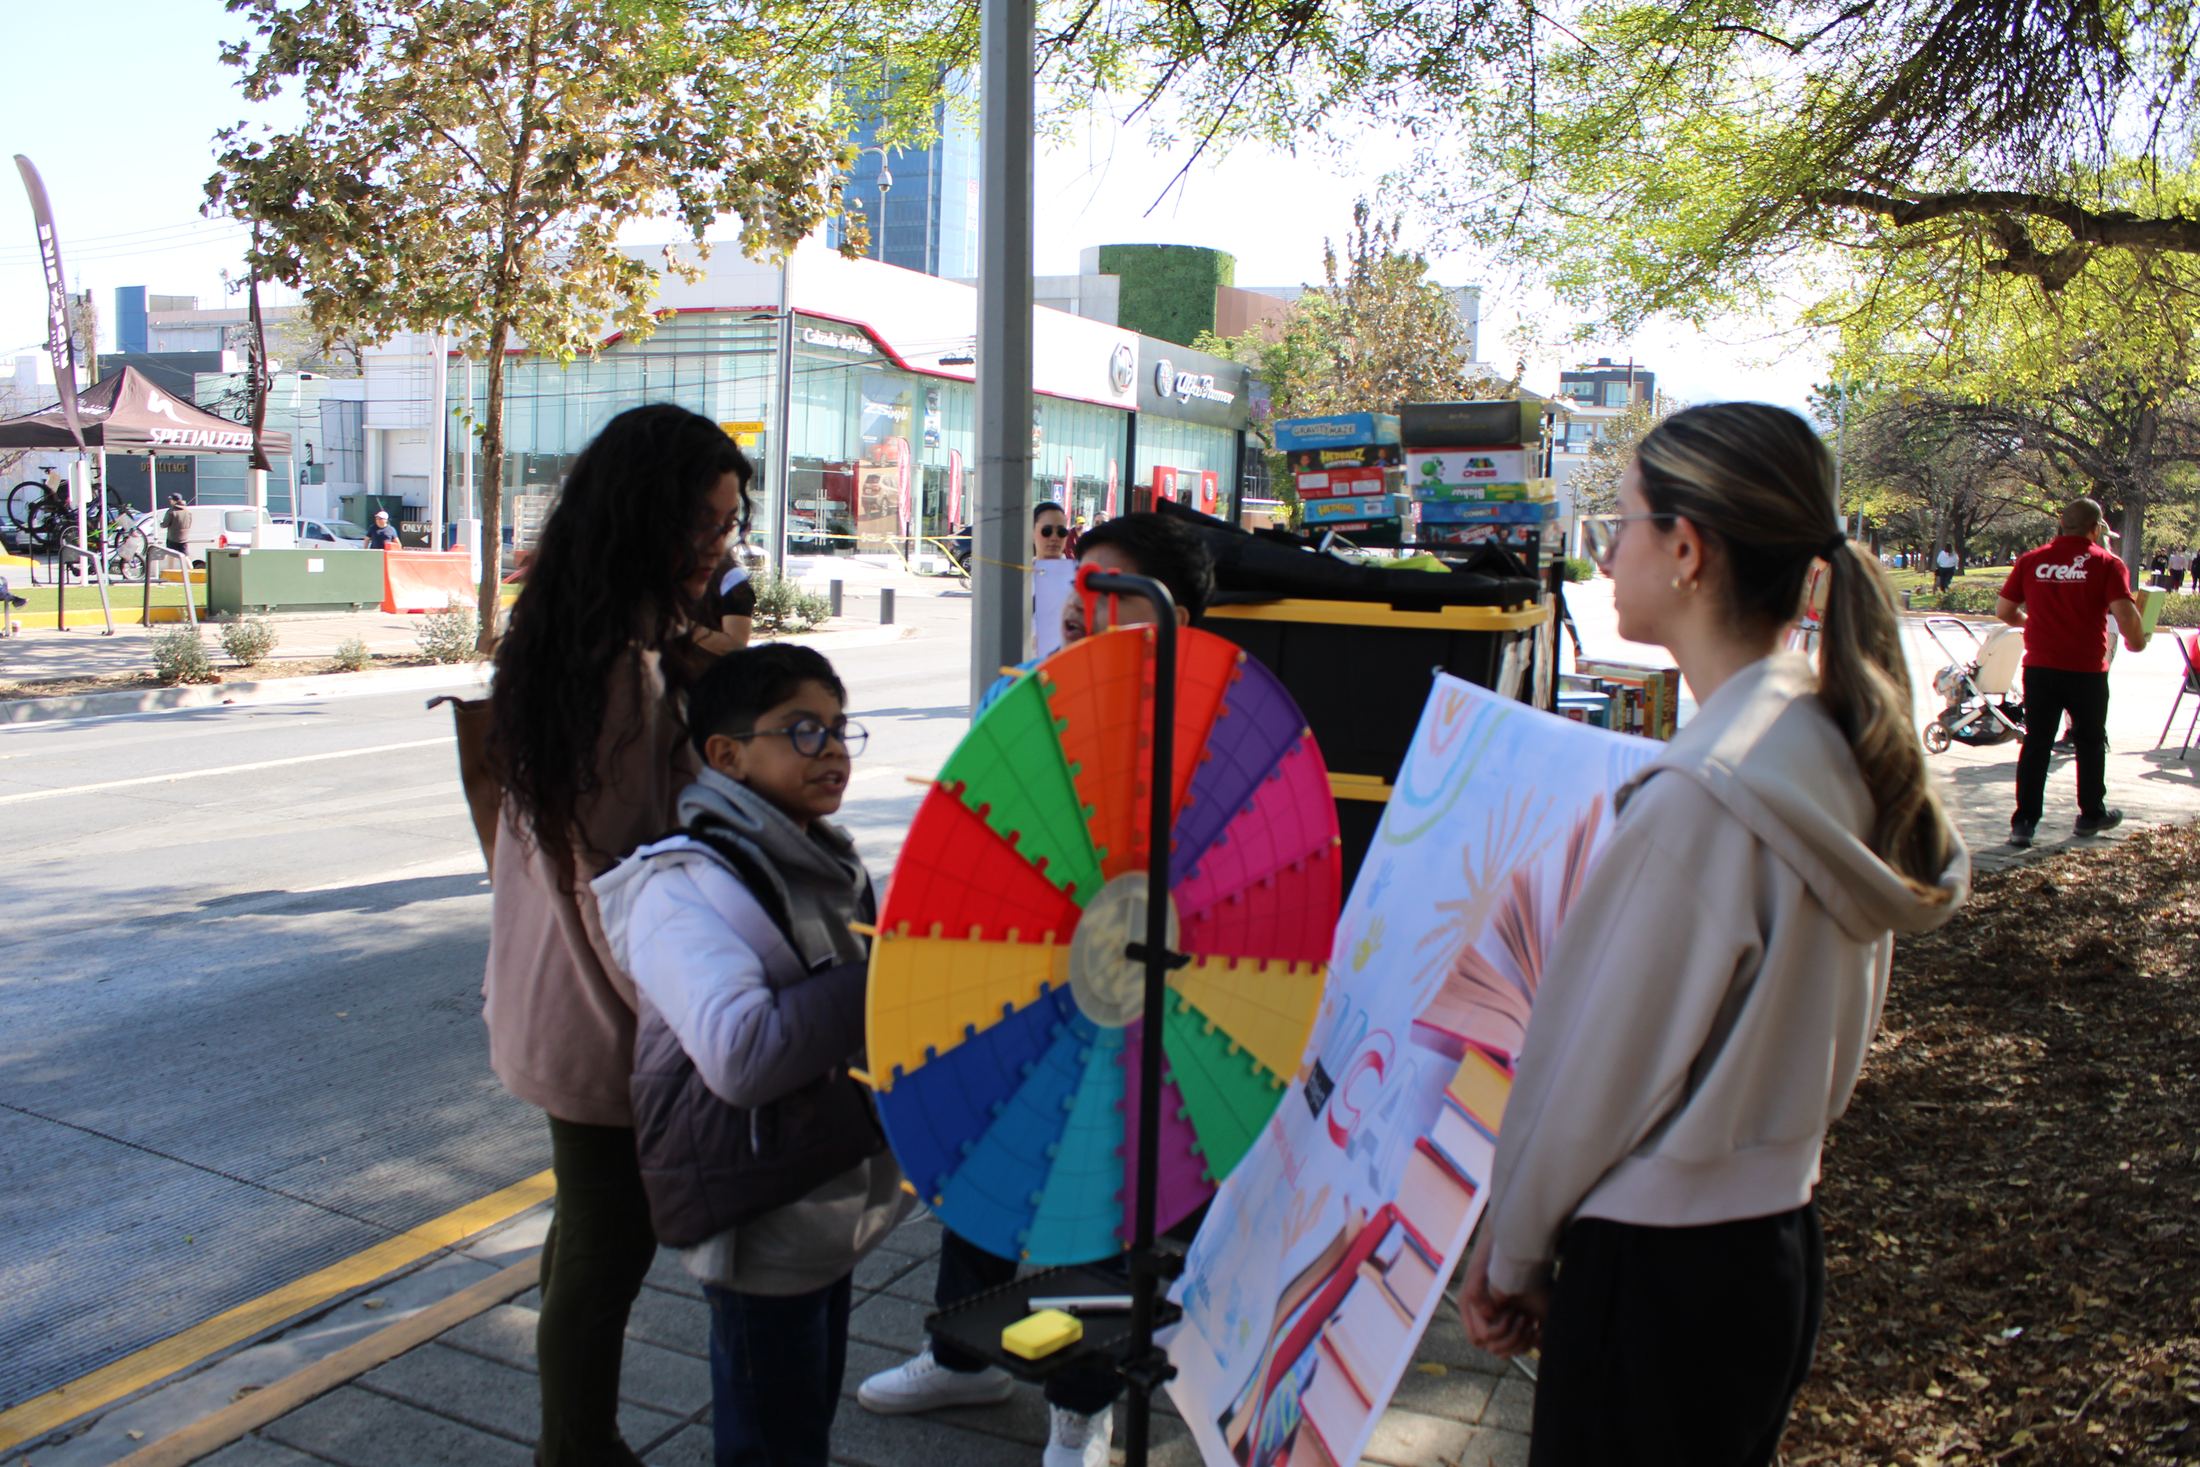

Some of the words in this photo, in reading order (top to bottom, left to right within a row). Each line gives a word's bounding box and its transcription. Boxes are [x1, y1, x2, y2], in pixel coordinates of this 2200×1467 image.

[39, 223, 58, 284] BIKE
[147, 428, 253, 450] SPECIALIZED
[401, 523, 421, 533] ONLY
